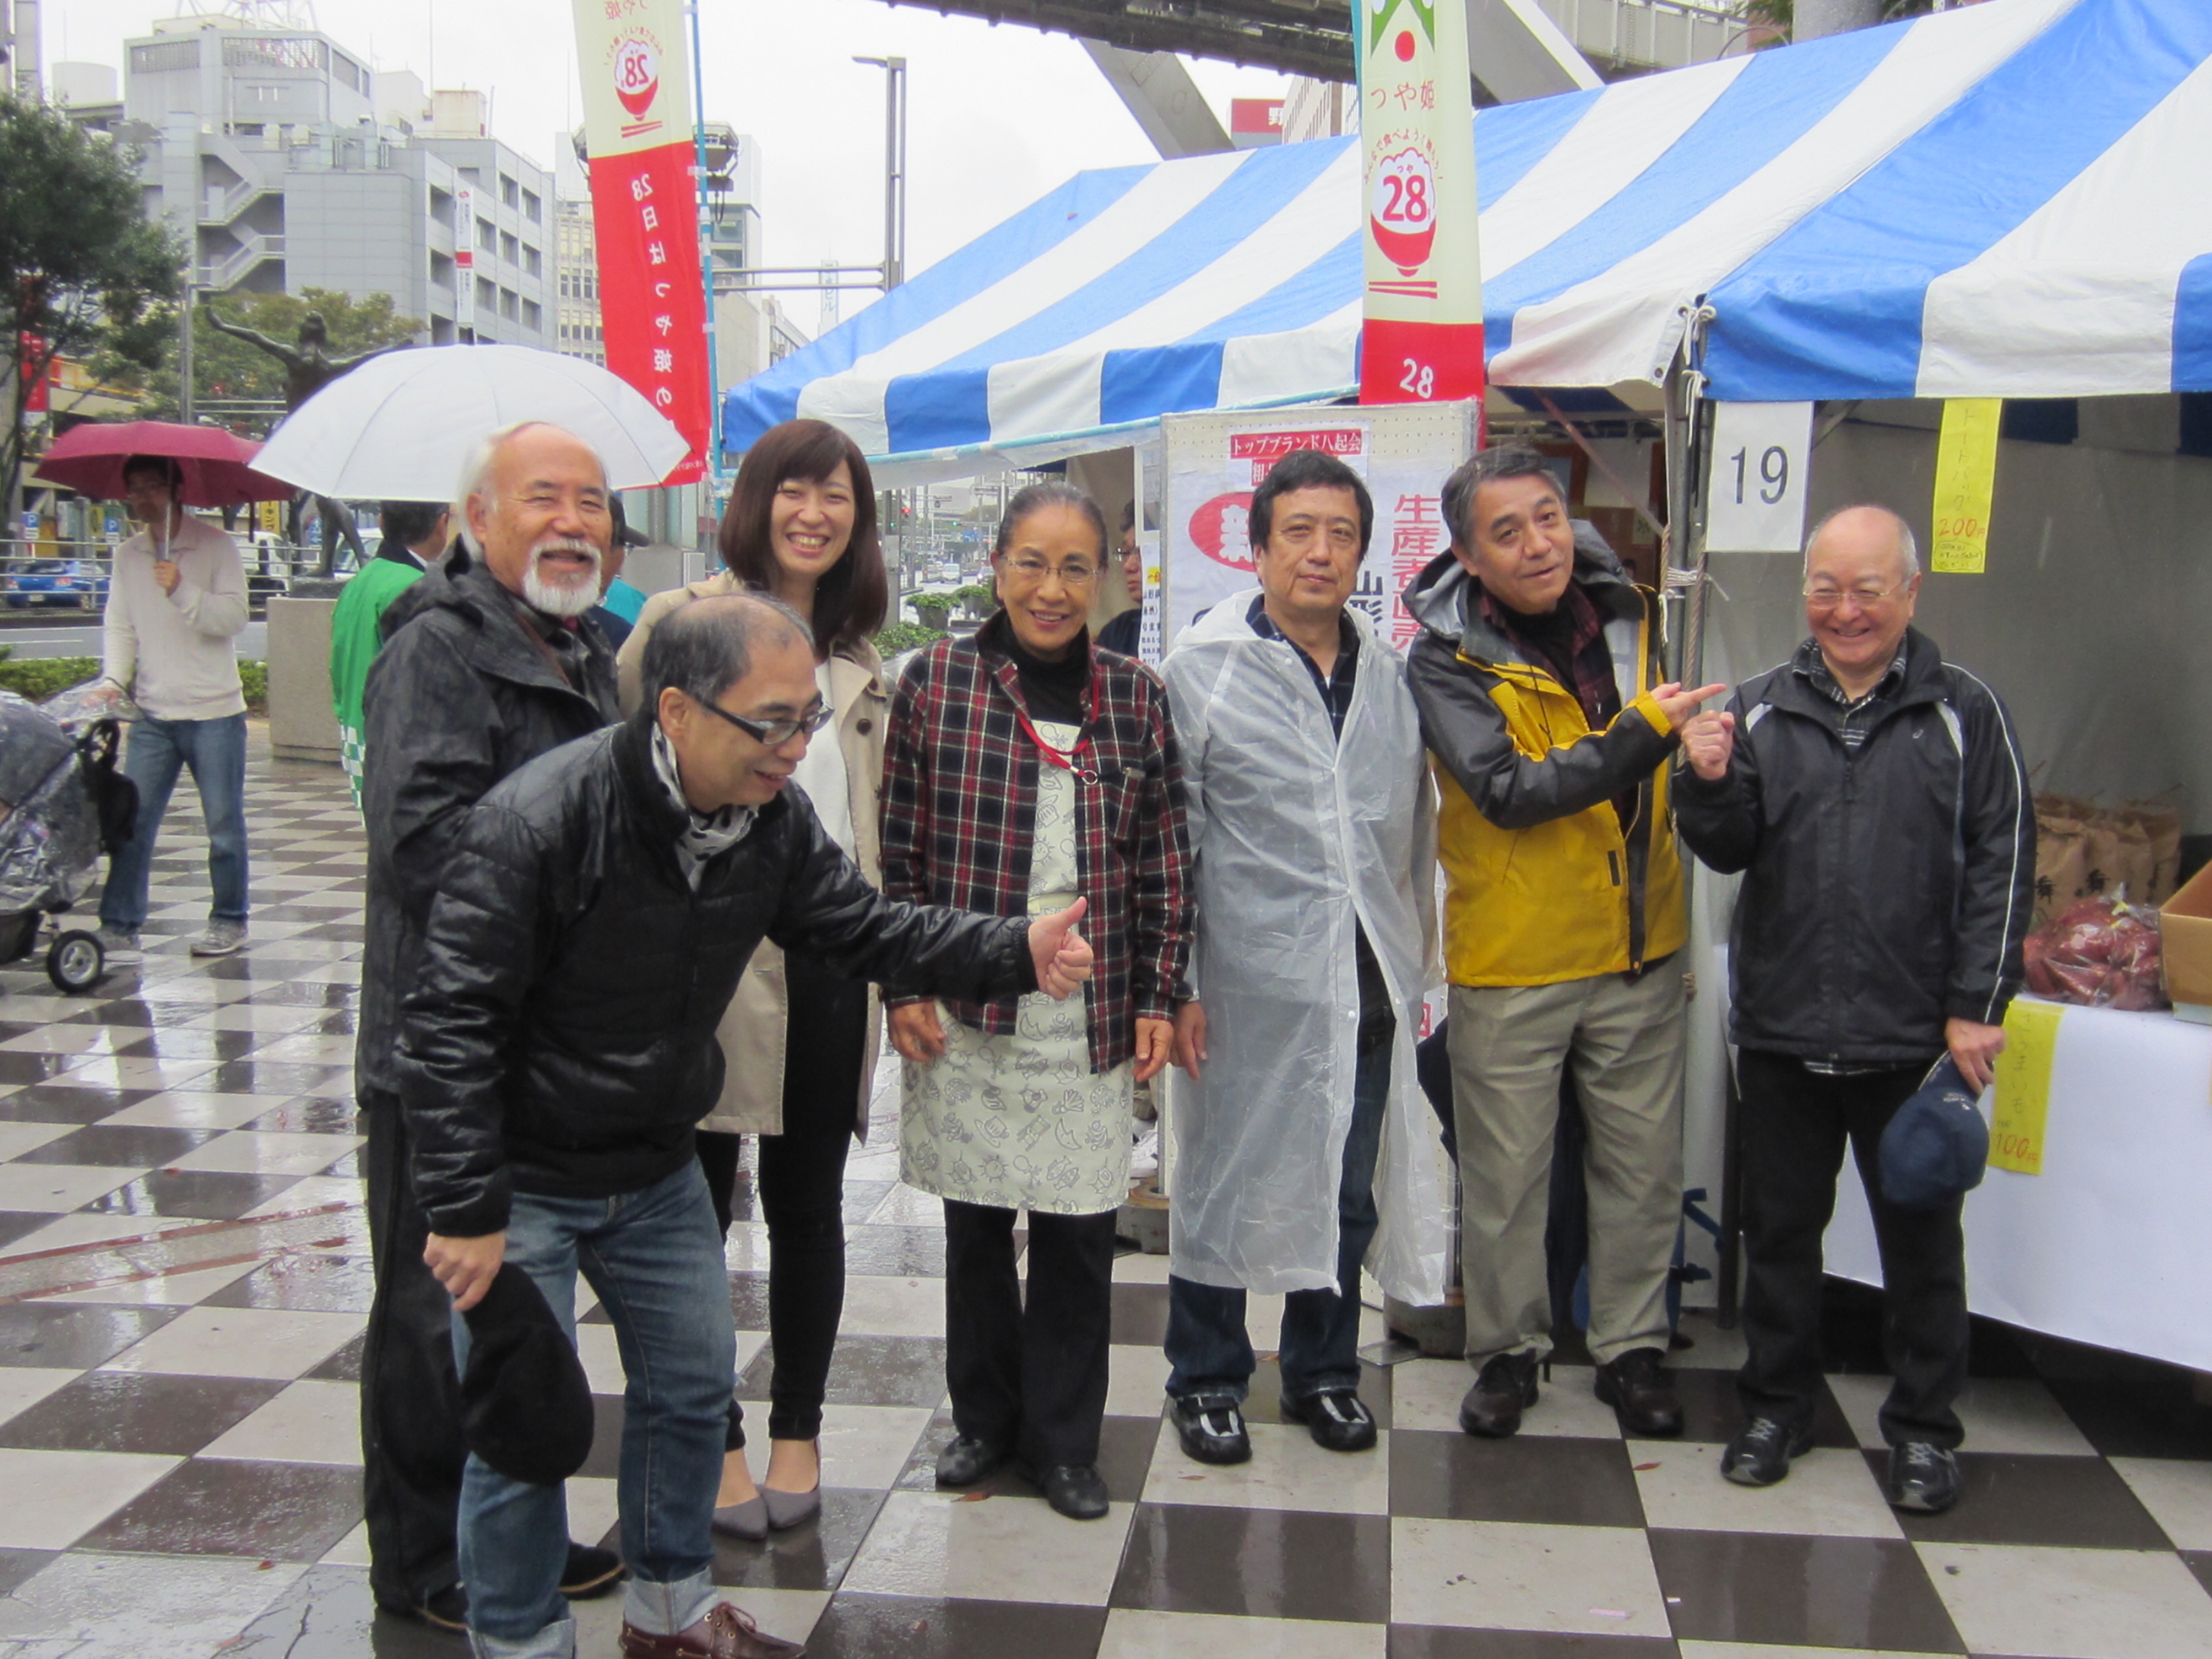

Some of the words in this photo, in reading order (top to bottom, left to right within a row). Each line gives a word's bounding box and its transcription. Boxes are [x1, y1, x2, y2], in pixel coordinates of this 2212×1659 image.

[1370, 80, 1435, 111] つや姫
[1396, 164, 1414, 174] つや
[1383, 175, 1428, 223] 28
[1399, 357, 1434, 399] 28
[1234, 432, 1361, 456] トップブランド八起会
[1951, 408, 1975, 512] トートバッグ
[1731, 445, 1789, 505] 19
[28, 515, 36, 526] P
[109, 520, 117, 530] P
[1349, 570, 1383, 638] 山形
